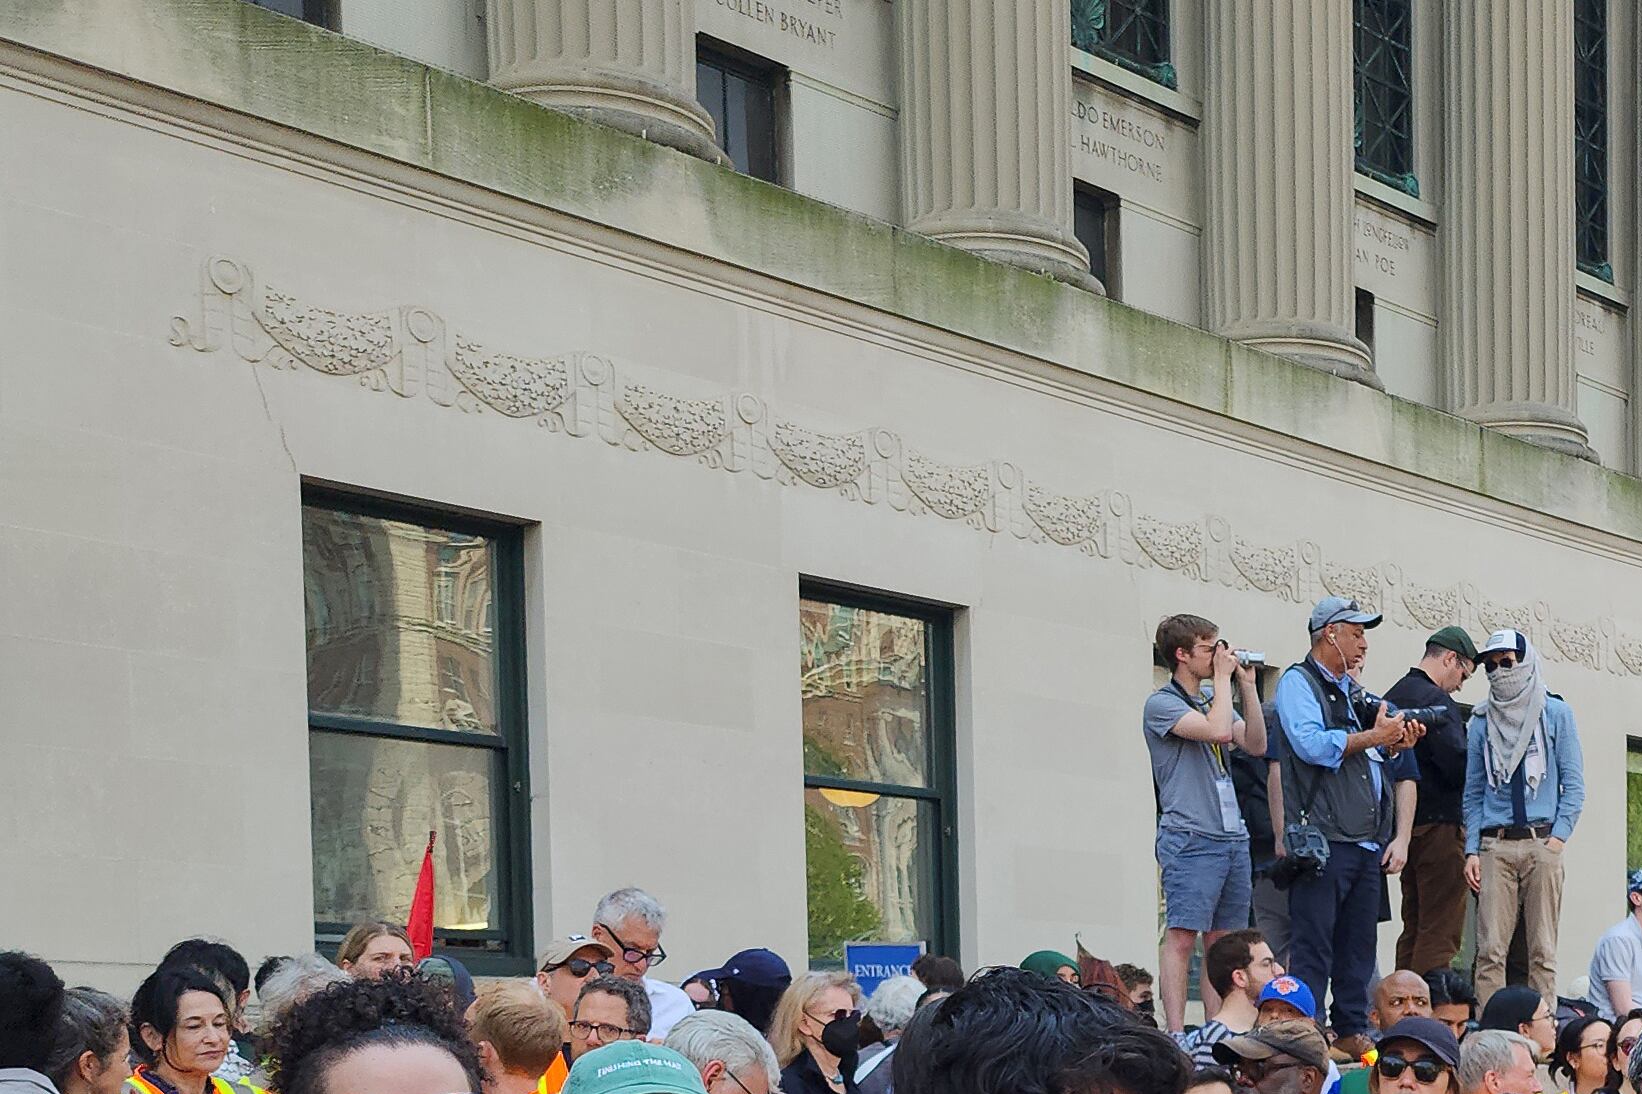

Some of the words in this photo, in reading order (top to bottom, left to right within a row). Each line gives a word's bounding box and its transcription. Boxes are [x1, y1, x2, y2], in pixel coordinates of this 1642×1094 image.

[780, 12, 836, 49] BRYANT
[1102, 112, 1166, 151] EMERSON
[1080, 134, 1163, 183] HAWTHORNE
[1375, 253, 1397, 277] POE
